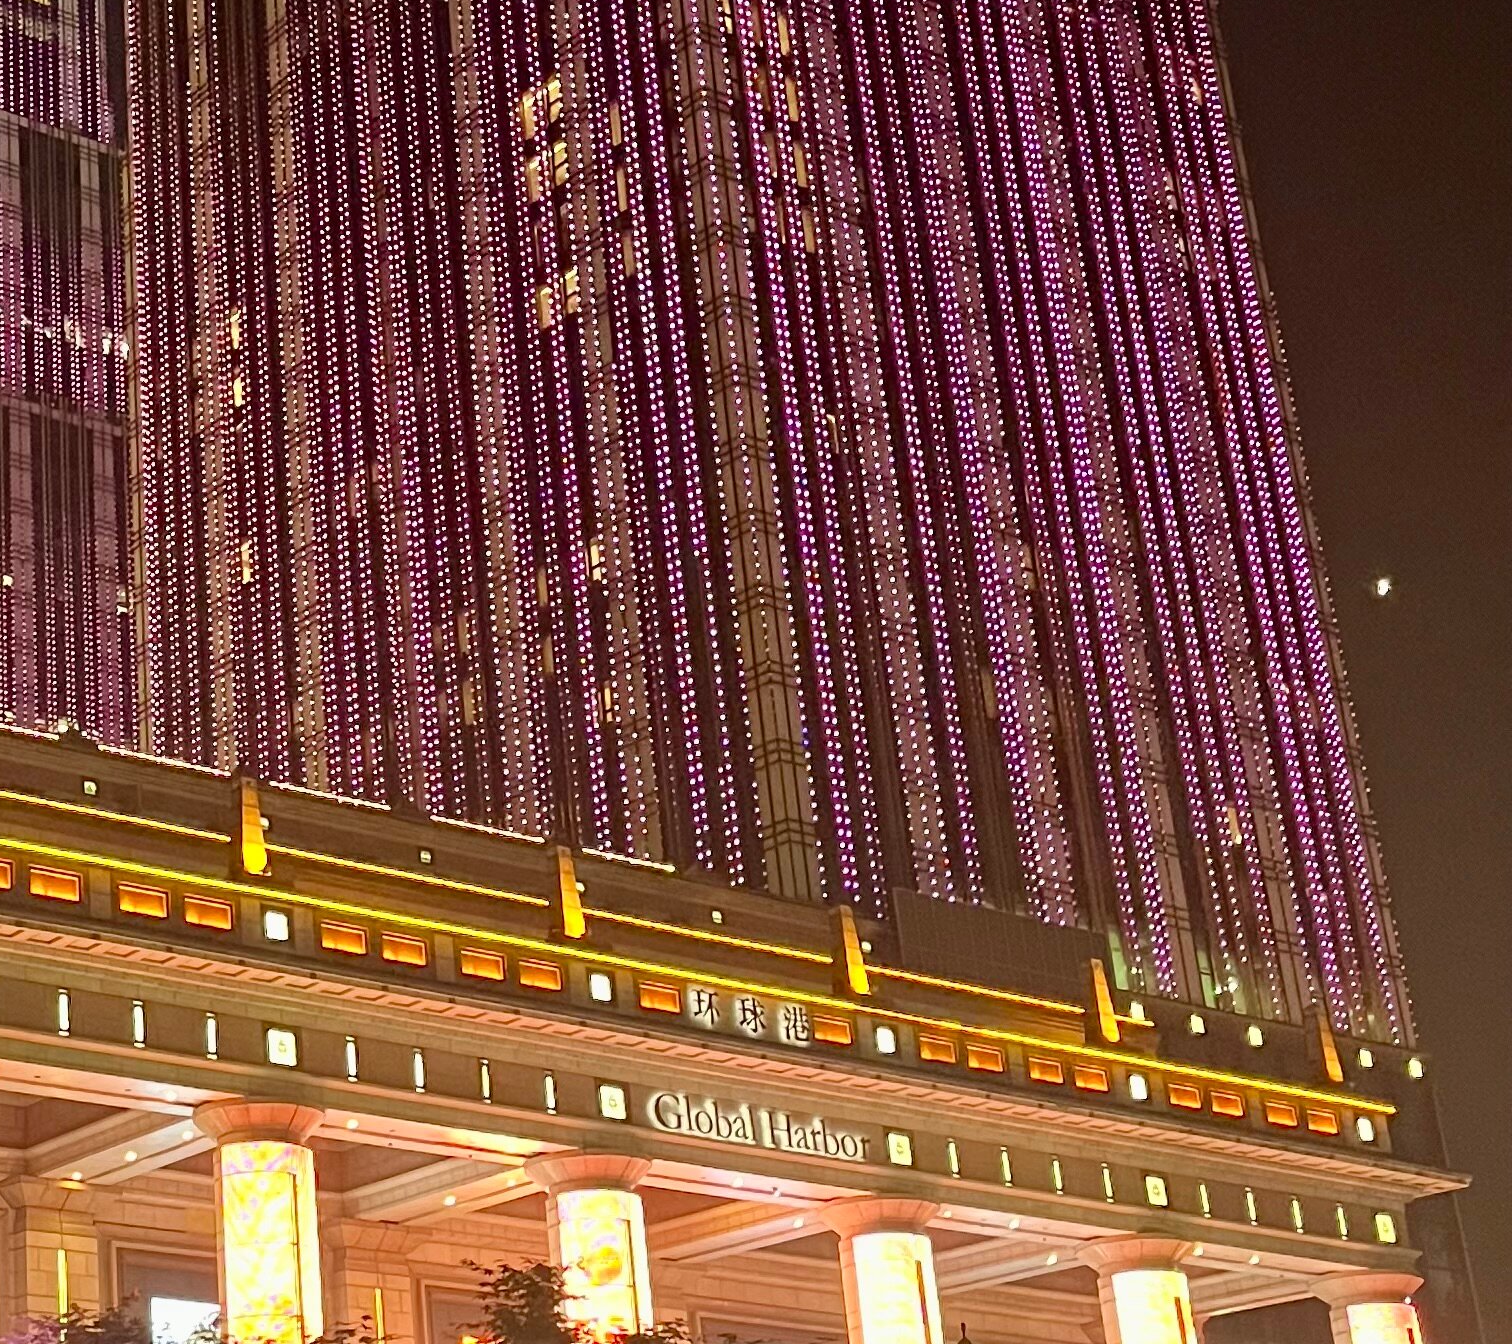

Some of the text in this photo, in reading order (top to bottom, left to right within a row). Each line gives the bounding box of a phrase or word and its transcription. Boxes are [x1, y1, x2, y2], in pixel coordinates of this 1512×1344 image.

[691, 988, 810, 1042] 环球港
[653, 1092, 871, 1160] Global Harbor
